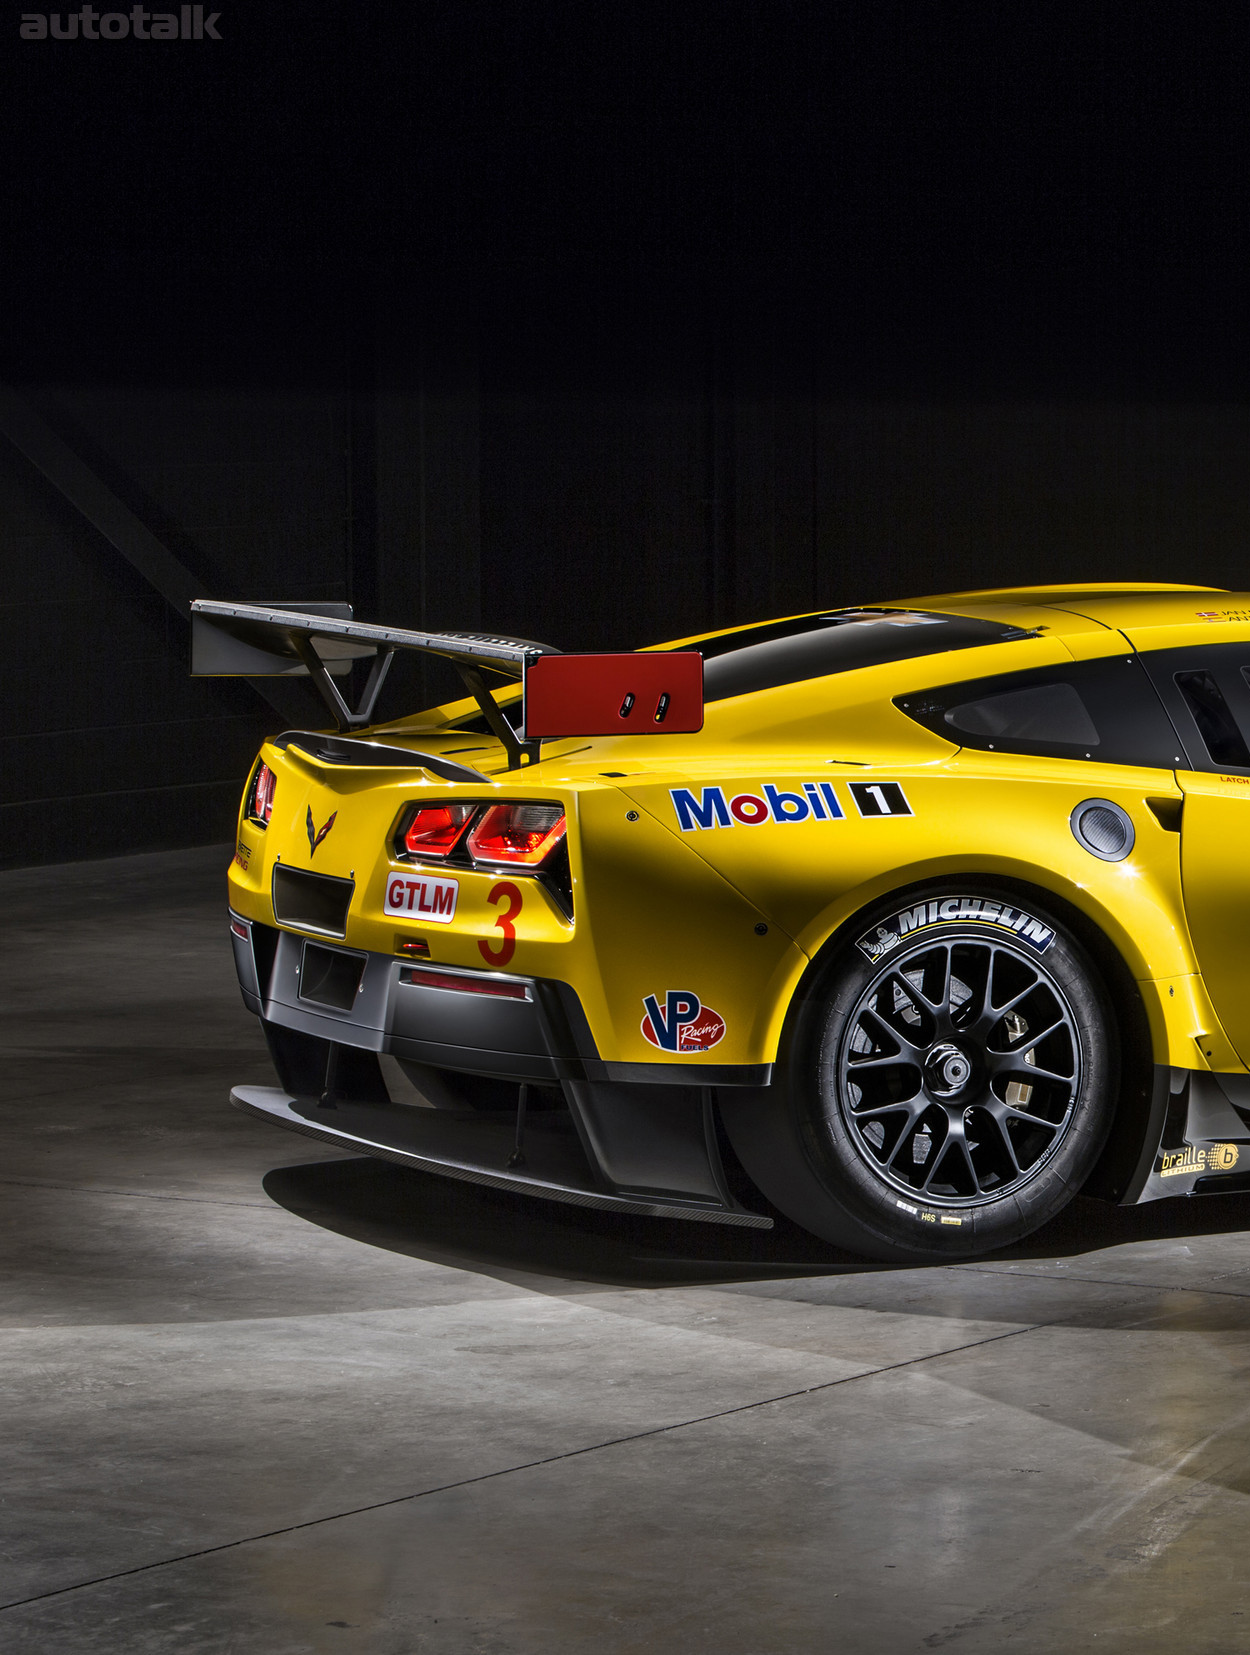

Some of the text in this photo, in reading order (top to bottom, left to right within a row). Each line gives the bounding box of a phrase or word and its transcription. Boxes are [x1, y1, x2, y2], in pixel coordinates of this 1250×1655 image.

[1220, 776, 1249, 785] LATCH
[669, 782, 847, 832] Mobil
[388, 879, 455, 916] GTLM
[477, 881, 523, 967] 3
[898, 899, 1052, 945] MICHELIN
[642, 990, 701, 1052] VP
[681, 1022, 725, 1043] Racing
[1161, 1164, 1205, 1177] LITHIUM
[1162, 1146, 1233, 1170] braille b
[921, 1212, 936, 1223] H6S
